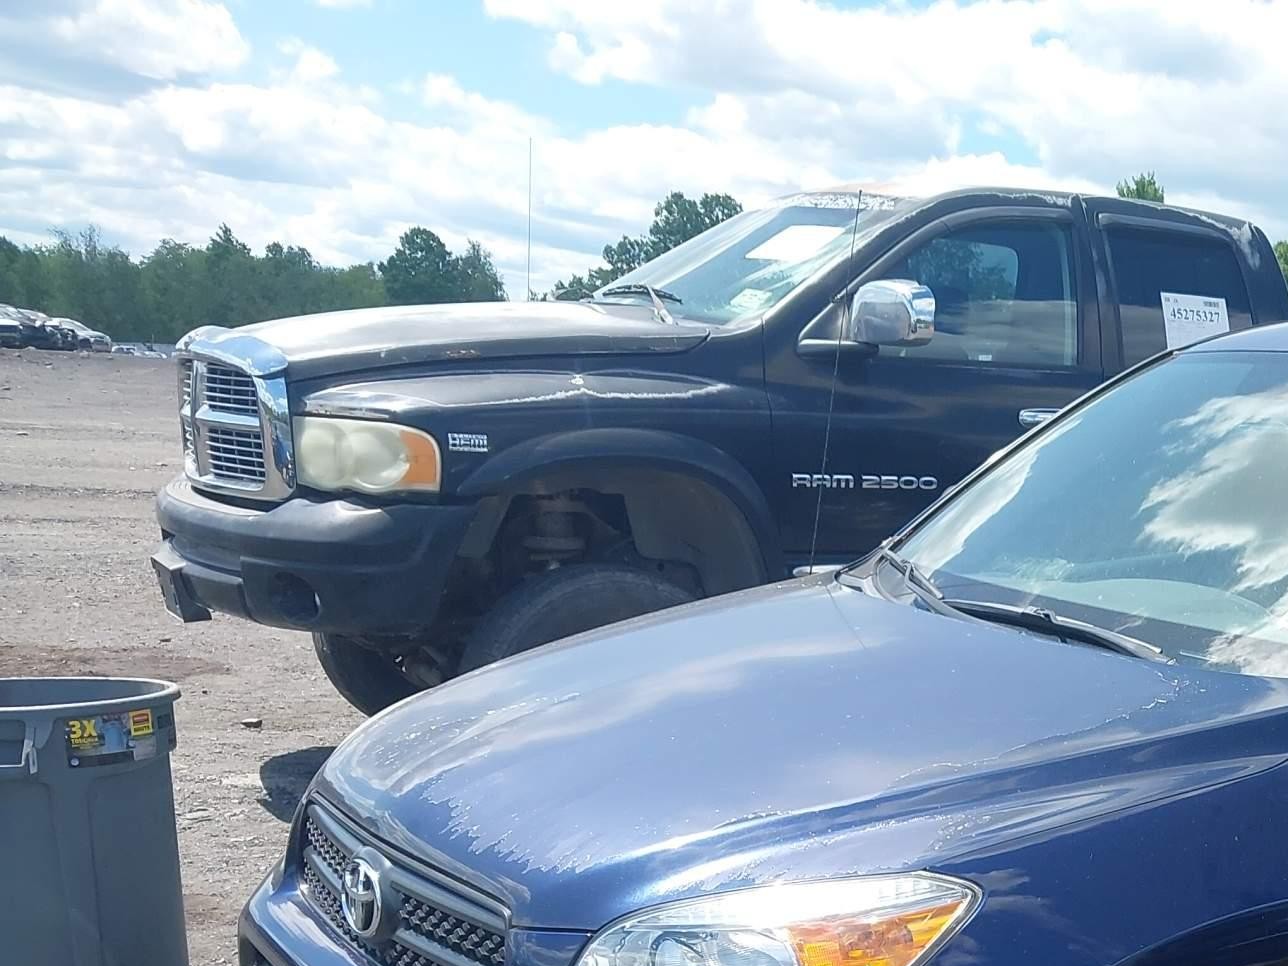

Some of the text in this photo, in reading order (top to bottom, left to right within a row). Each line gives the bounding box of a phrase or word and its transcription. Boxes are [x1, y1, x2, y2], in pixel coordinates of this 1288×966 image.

[1170, 307, 1220, 323] 45275327
[792, 473, 938, 489] RAM 2500
[68, 720, 97, 739] 3X
